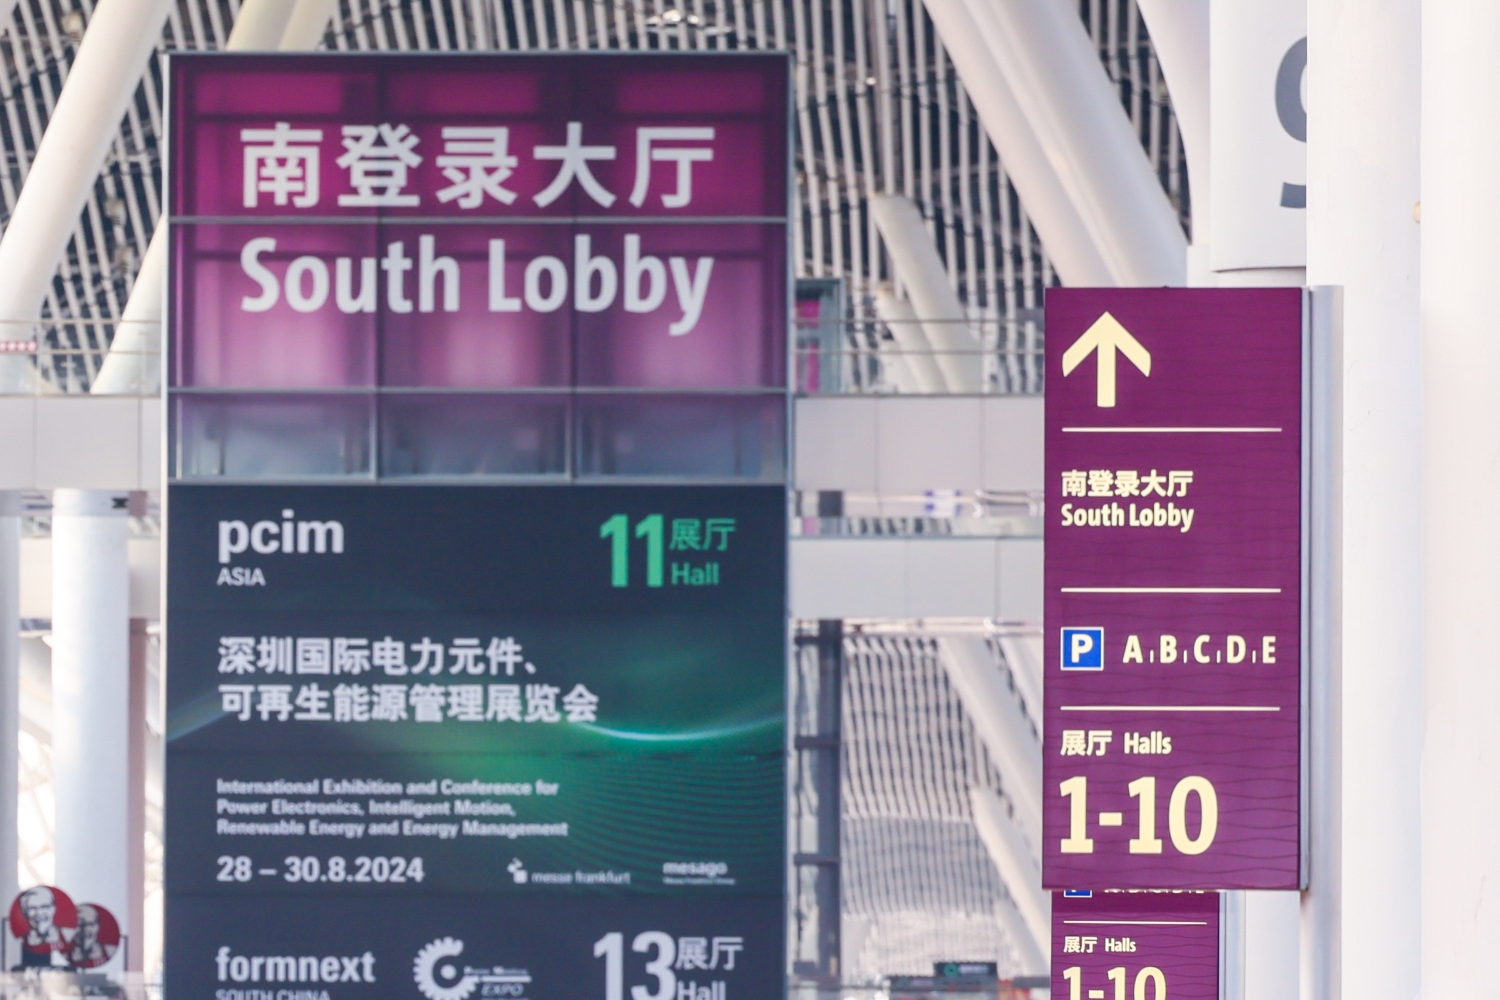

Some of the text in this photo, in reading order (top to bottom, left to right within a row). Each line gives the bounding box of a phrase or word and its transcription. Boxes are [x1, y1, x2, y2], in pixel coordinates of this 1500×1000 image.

[240, 122, 715, 209] 南登录大厅
[241, 235, 714, 336] South Lobby
[1061, 470, 1194, 498] 南登录大厅
[1061, 503, 1195, 533] South Lobby
[218, 509, 344, 563] pcim
[669, 518, 736, 551] 展厅
[601, 514, 664, 588] 11
[217, 567, 266, 587] ASIA
[671, 563, 719, 586] Hall
[218, 637, 538, 675] 深圳国际电力元件、
[218, 684, 599, 722] 可再生能源管理展览会
[1060, 730, 1172, 757] 展厅 Halls
[217, 778, 560, 795] International Exhibition and Conference for
[217, 799, 516, 818] Power Electronics, Intelligent Motion,
[1059, 775, 1219, 855] 1-10
[217, 820, 569, 839] Renewable Energy and Energy Management
[217, 857, 252, 882] 28
[284, 857, 425, 882] 30.8.2024
[532, 870, 631, 884] messe frankfurt
[663, 861, 728, 877] mesago
[675, 937, 743, 971] 展厅
[1063, 936, 1137, 953] 展厅 Halls
[215, 946, 376, 983] formnext
[481, 984, 524, 997] EXPO
